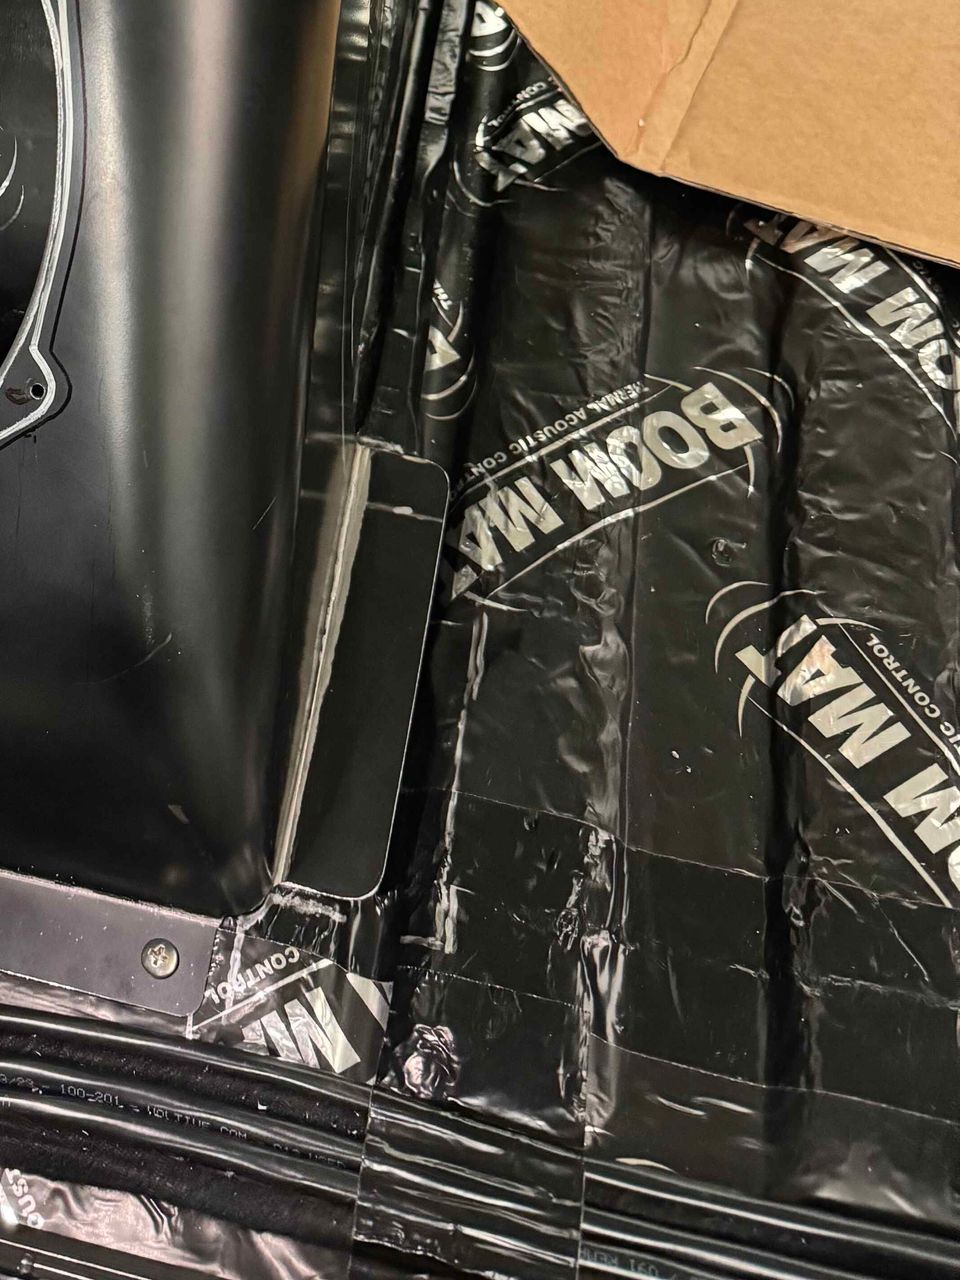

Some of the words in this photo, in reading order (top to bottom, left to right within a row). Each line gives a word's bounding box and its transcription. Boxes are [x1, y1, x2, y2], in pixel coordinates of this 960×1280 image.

[509, 407, 588, 455] ACOUSTIC
[549, 382, 764, 511] BOOM
[735, 614, 911, 769] MAT
[865, 632, 941, 719] CONTROL
[204, 946, 301, 1005] CONTROL
[242, 986, 361, 1074] MA
